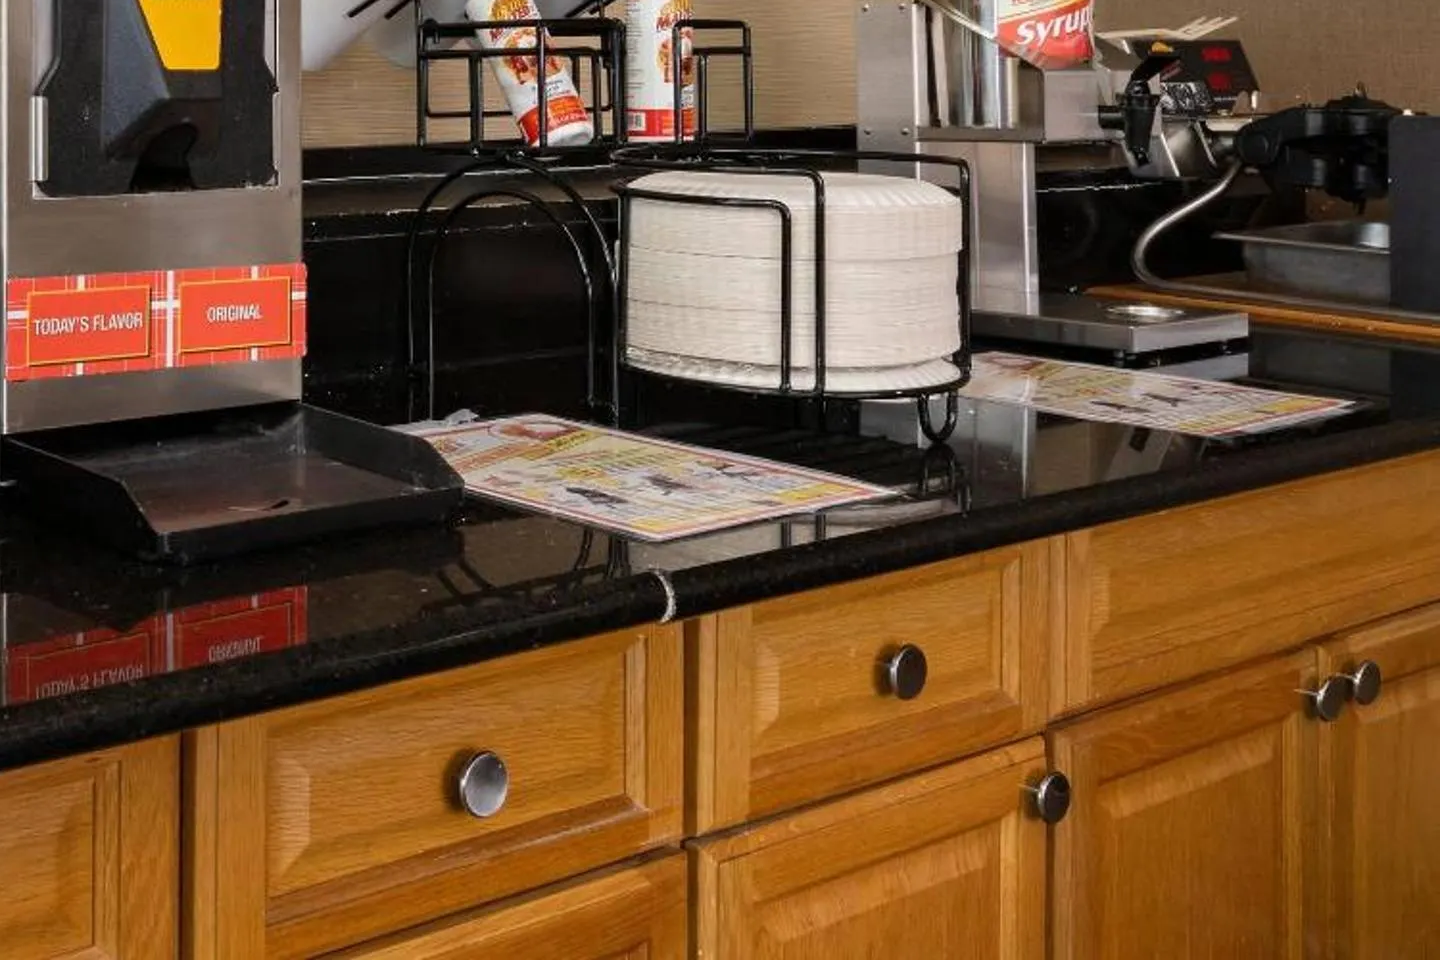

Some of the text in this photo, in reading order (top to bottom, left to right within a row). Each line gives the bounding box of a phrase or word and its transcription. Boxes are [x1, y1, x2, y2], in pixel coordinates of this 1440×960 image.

[34, 311, 143, 336] TODAY'S FLAVOR
[207, 303, 263, 323] ORIGINAL
